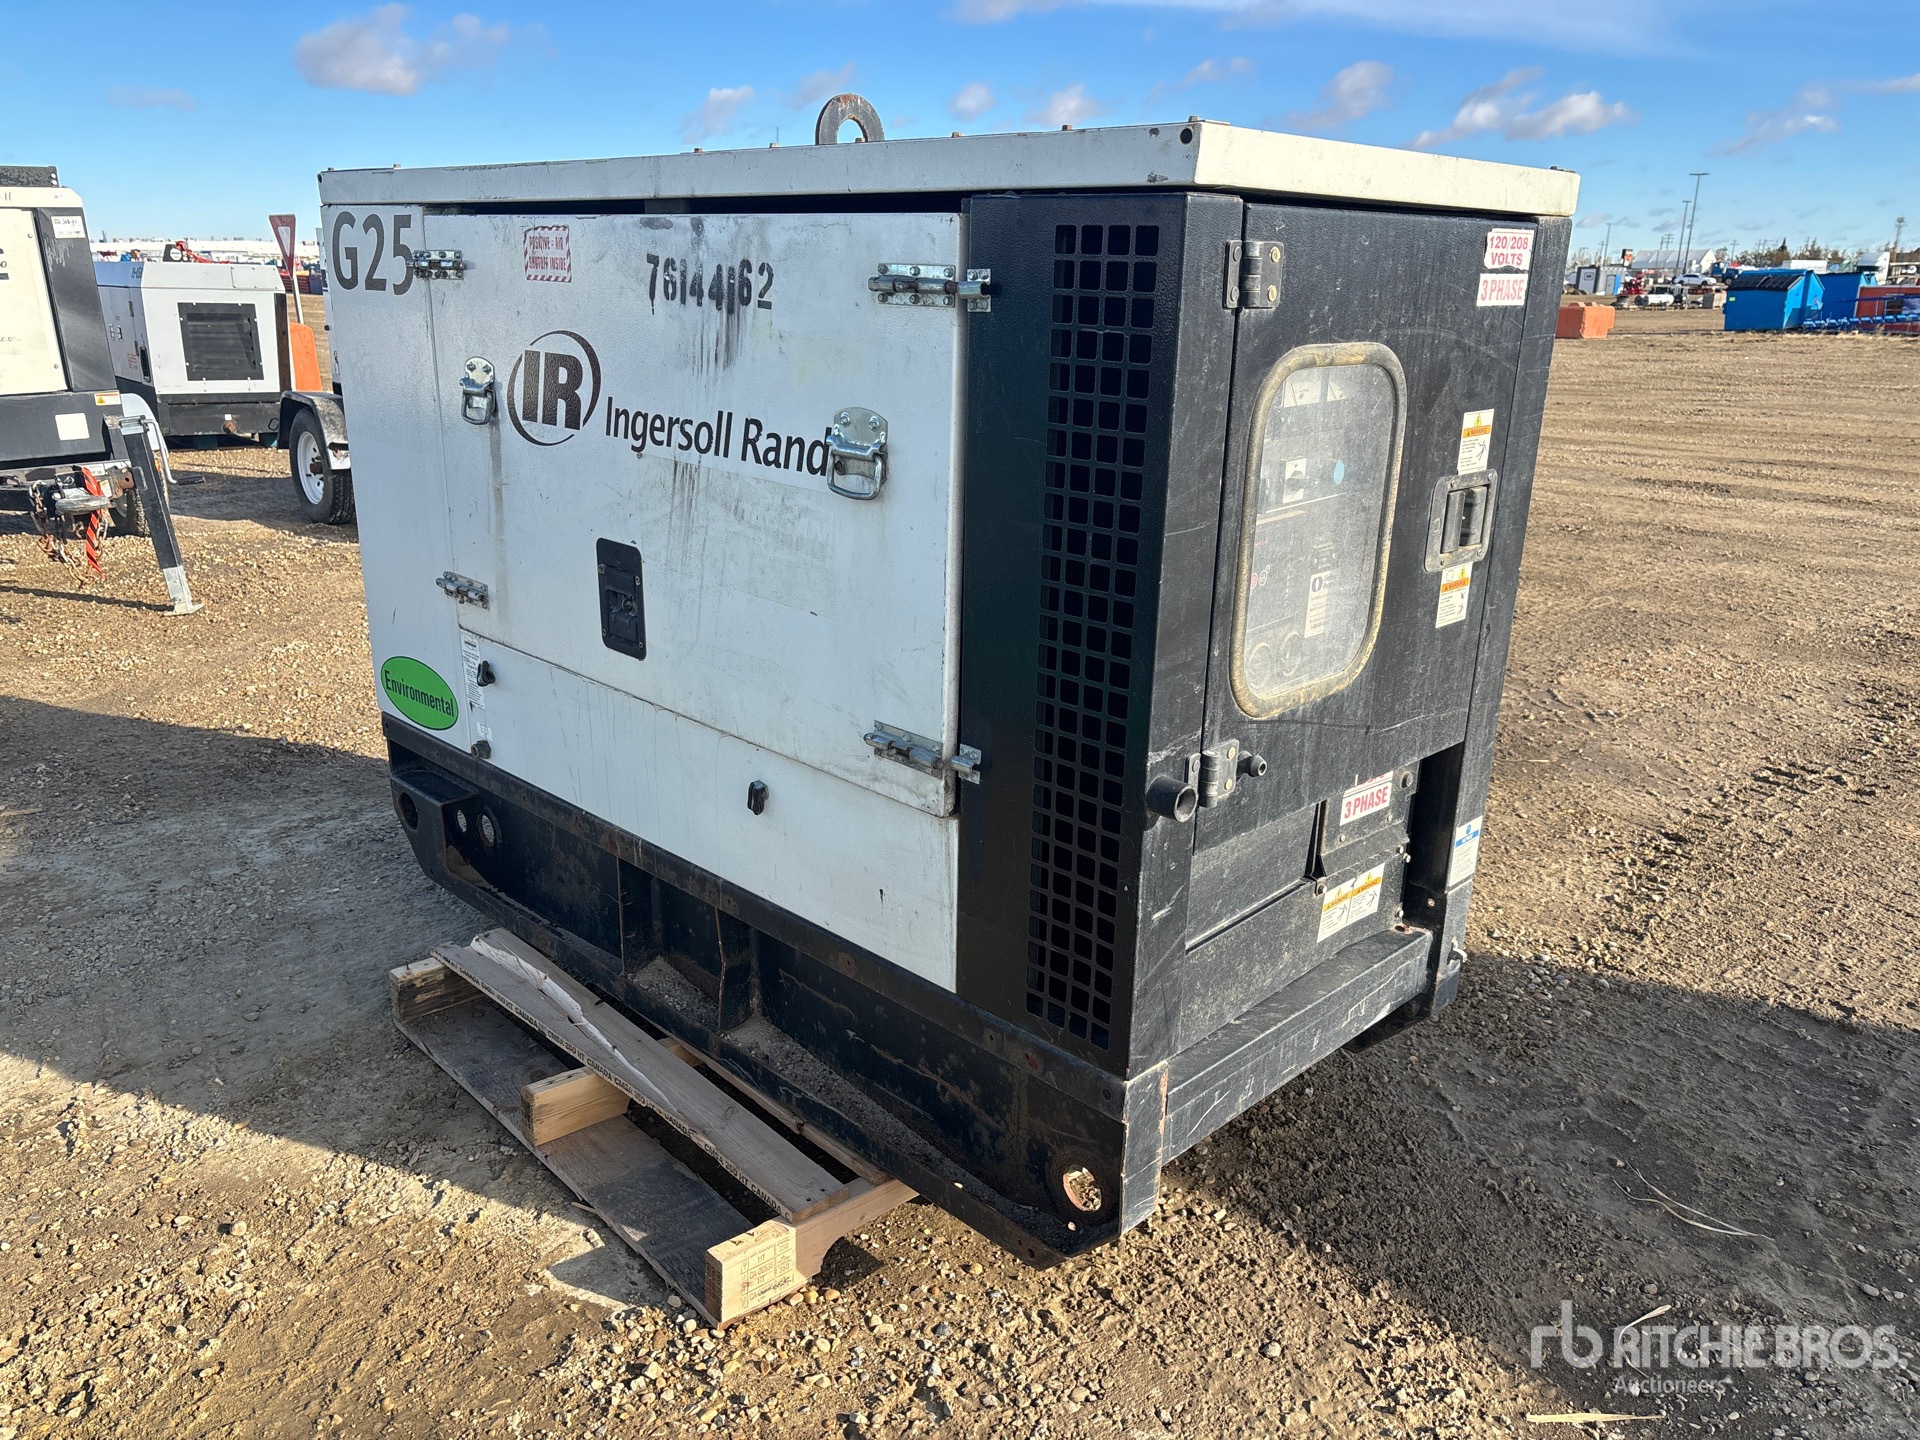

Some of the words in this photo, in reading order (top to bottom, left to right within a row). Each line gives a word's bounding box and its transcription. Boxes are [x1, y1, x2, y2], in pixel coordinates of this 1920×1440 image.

[331, 211, 413, 296] G25
[1489, 235, 1529, 250] 120/208
[1491, 252, 1523, 267] VOLTS
[1481, 280, 1488, 301] 3
[1489, 279, 1525, 301] PHASE
[521, 349, 585, 431] IR
[605, 396, 734, 459] Ingersoll
[740, 417, 833, 477] Rand
[384, 669, 455, 718] Environmental
[1344, 803, 1353, 819] 3
[1353, 786, 1389, 815] PHASE
[739, 1173, 749, 1186] HT
[751, 1184, 782, 1214] CANADA
